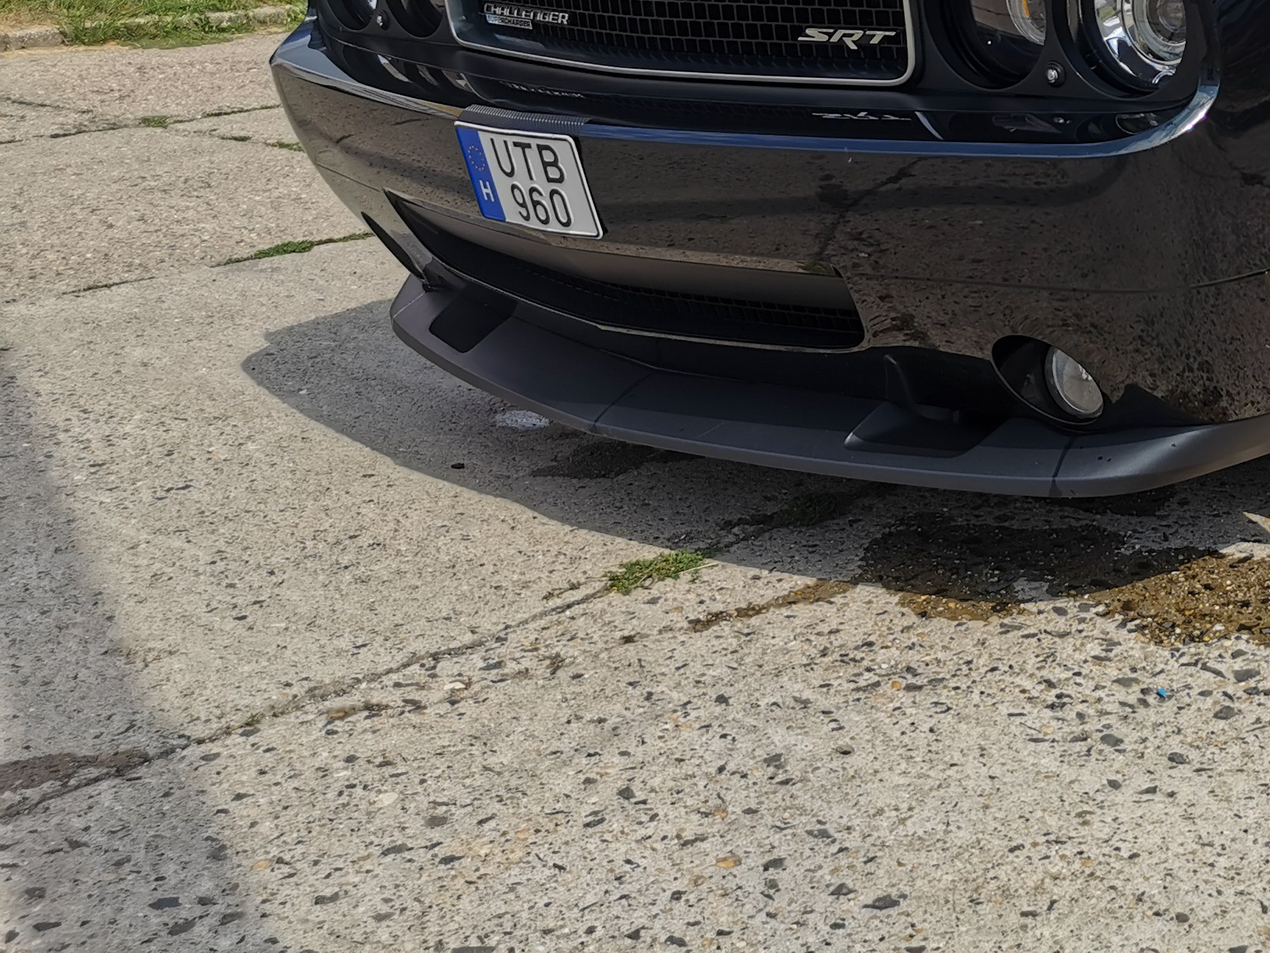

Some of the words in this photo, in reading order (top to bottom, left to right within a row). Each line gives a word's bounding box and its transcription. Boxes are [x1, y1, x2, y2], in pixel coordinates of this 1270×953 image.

[484, 3, 570, 25] CHALLENGER
[797, 28, 897, 49] SRT
[490, 138, 565, 184] UTB
[479, 179, 495, 203] H
[510, 183, 572, 228] 960
